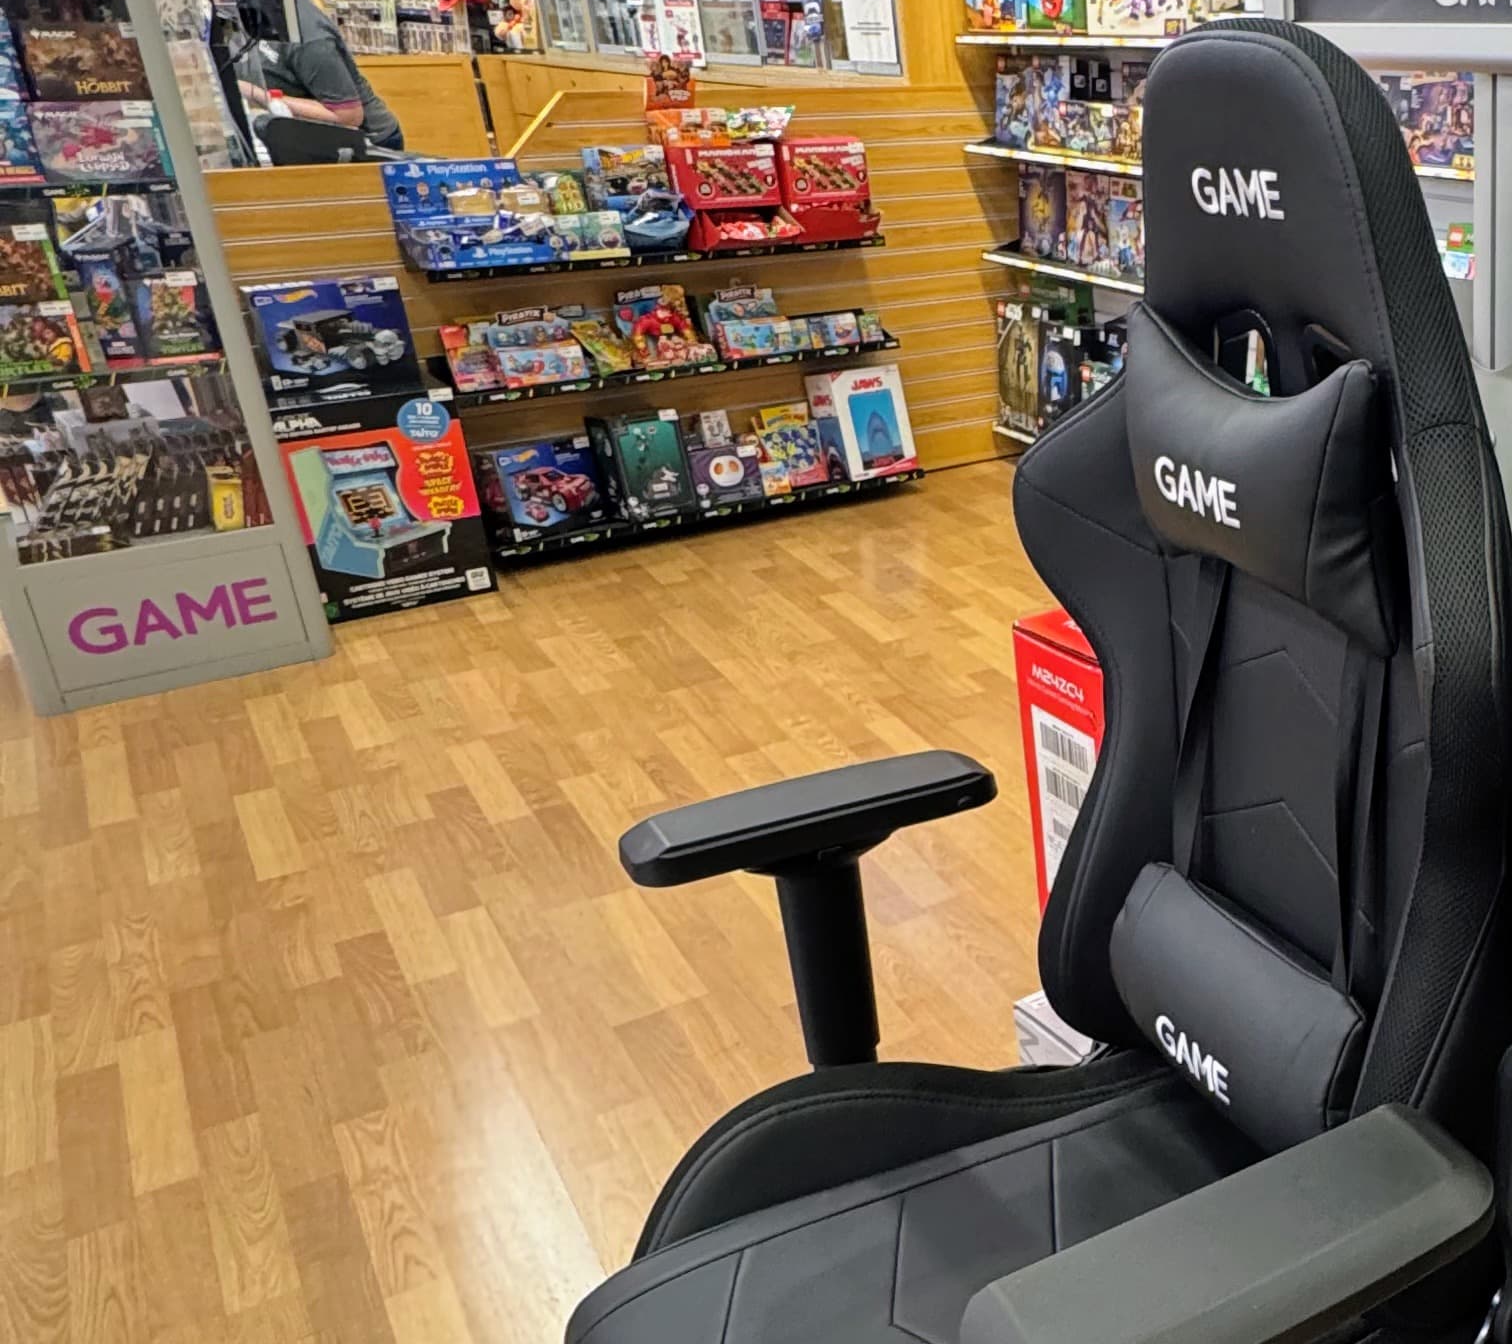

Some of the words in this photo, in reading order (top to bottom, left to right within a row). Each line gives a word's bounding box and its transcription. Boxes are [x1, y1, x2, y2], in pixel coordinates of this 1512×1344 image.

[75, 80, 132, 96] HOBBIT
[426, 164, 488, 177] PlayStation
[1191, 167, 1284, 220] GAME
[850, 376, 884, 392] JAWS
[415, 402, 433, 416] 10
[1154, 456, 1241, 529] GAME
[68, 577, 278, 654] GAME
[1155, 1014, 1232, 1106] GAME
